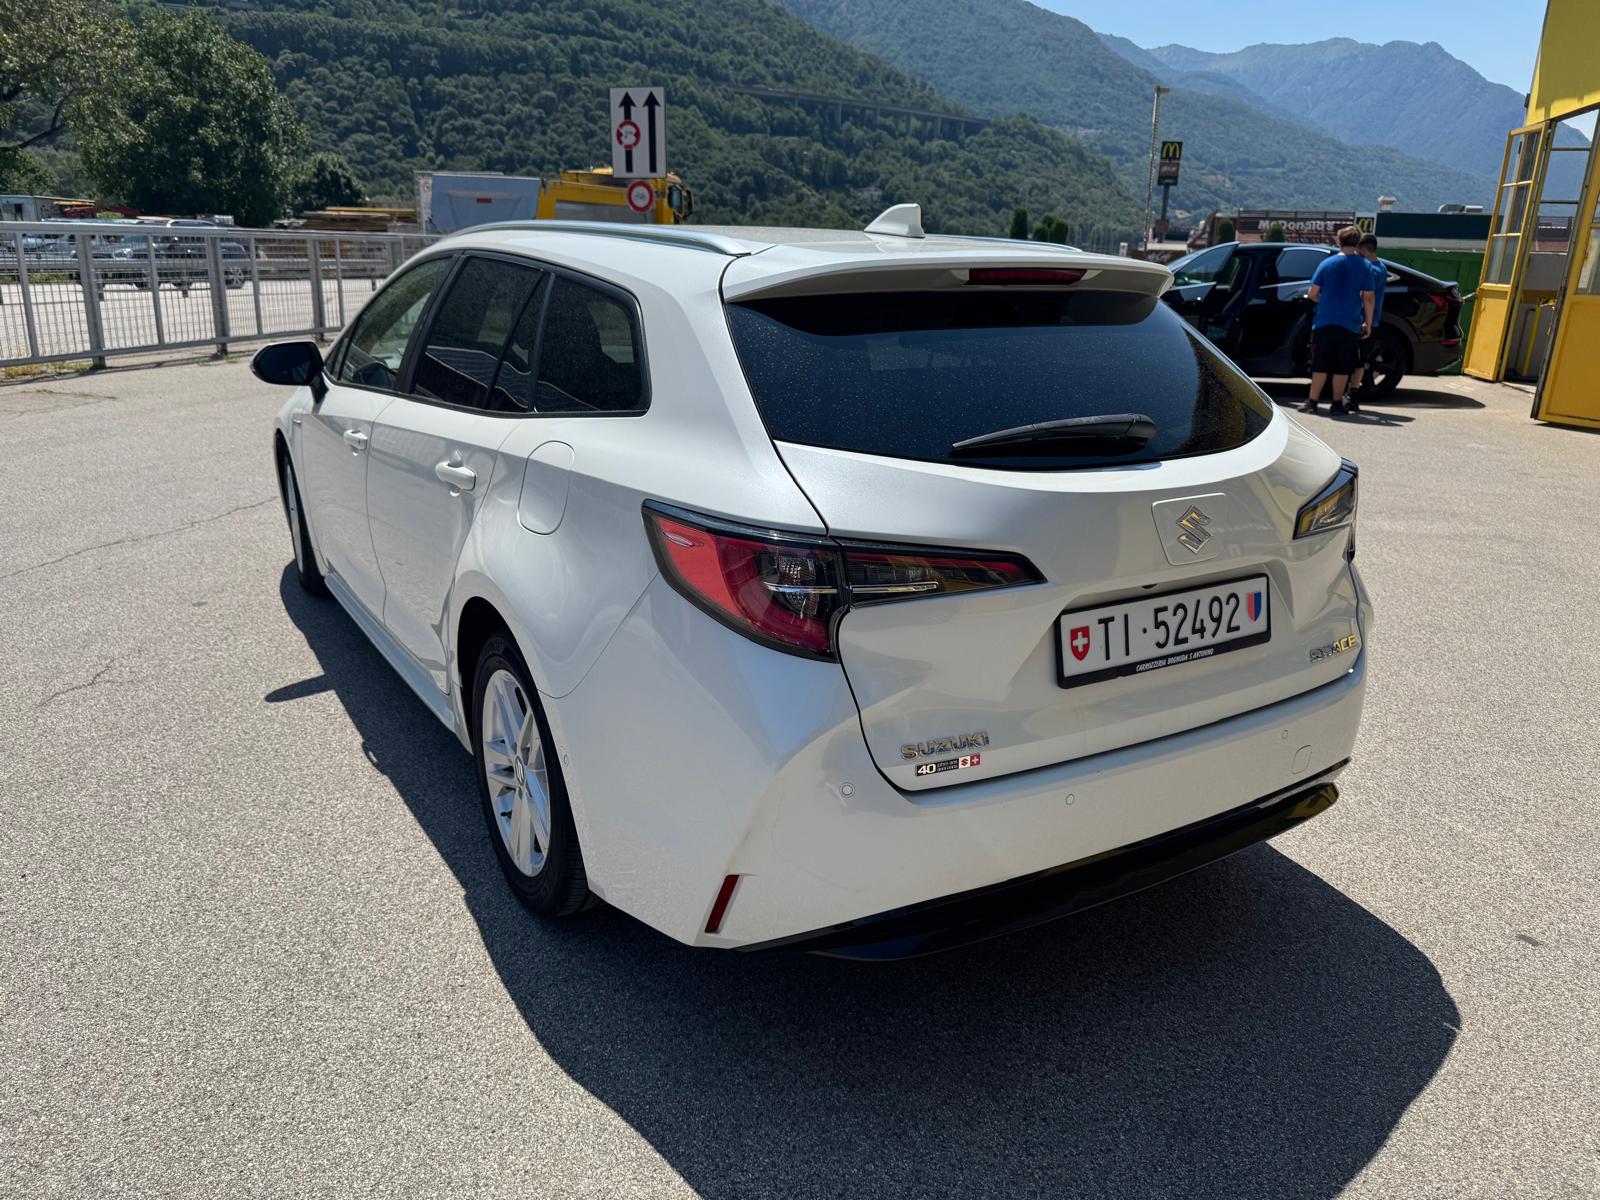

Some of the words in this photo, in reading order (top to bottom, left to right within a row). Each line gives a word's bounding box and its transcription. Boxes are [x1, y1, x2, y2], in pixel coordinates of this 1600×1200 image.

[1153, 592, 1240, 649] 52492
[901, 732, 989, 760] SUZUKI
[918, 764, 936, 775] 40
